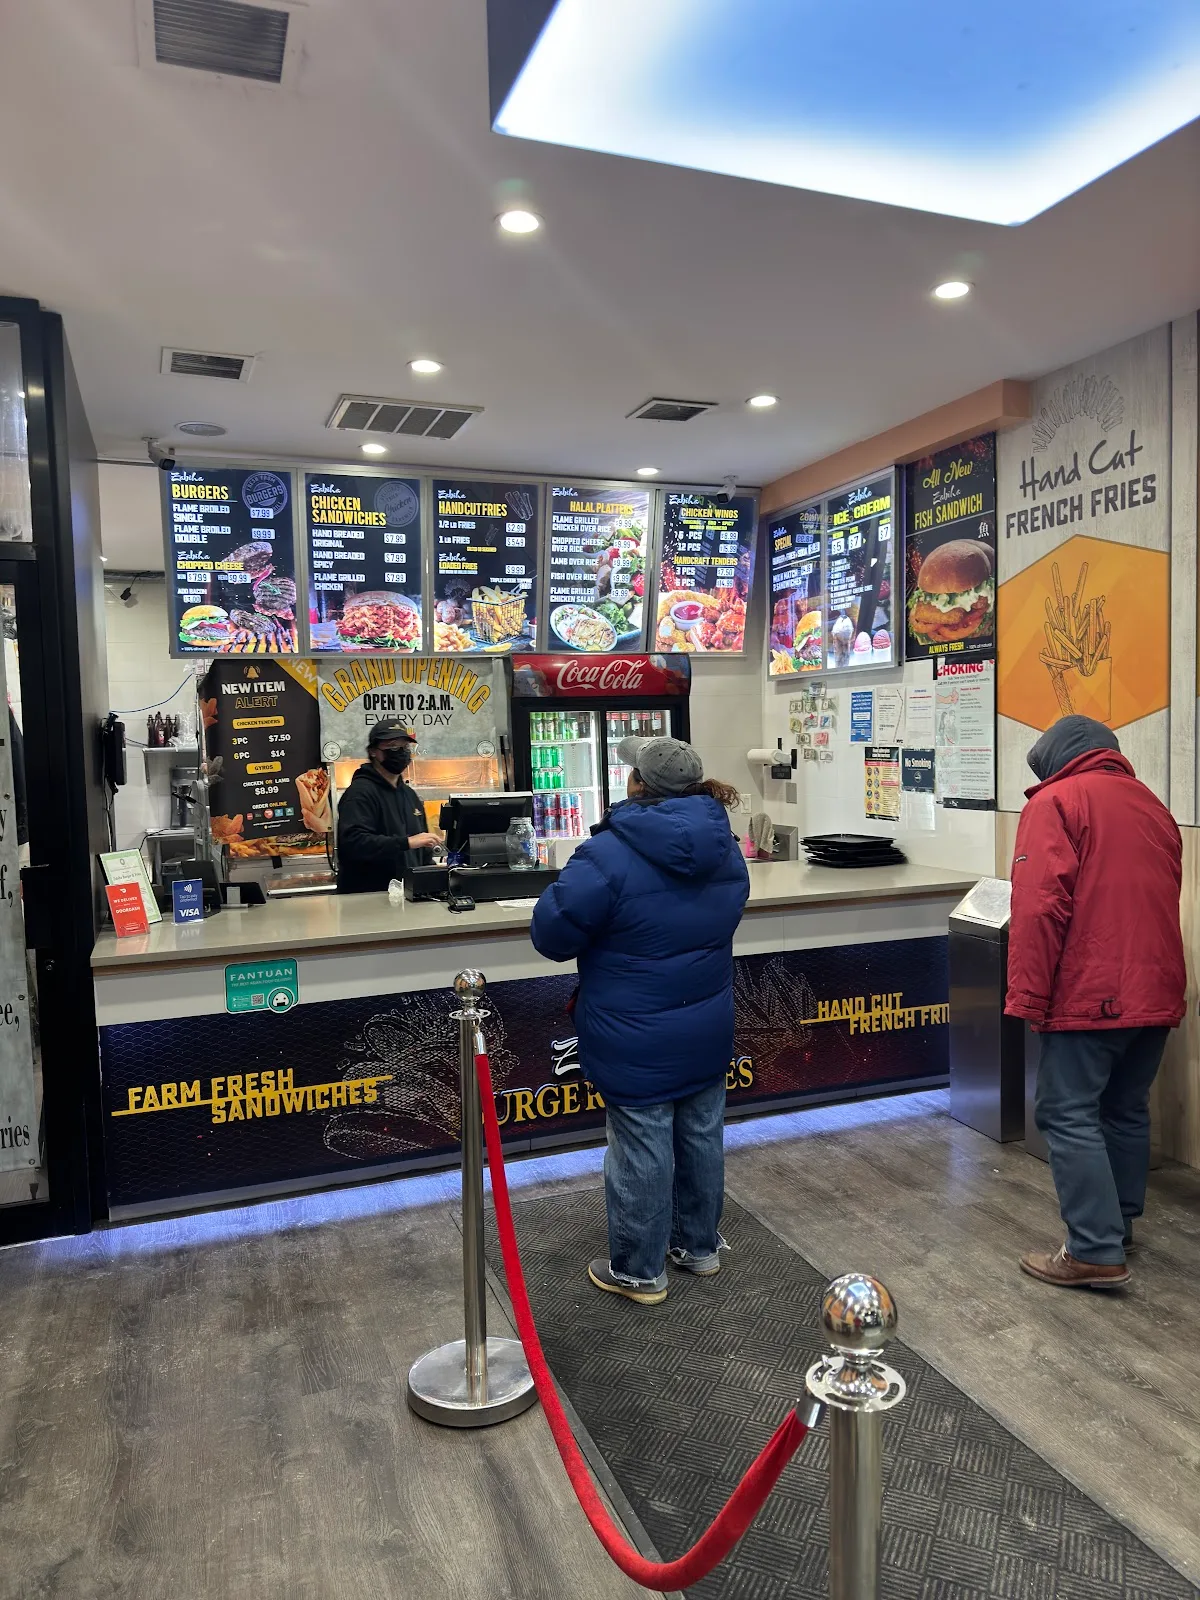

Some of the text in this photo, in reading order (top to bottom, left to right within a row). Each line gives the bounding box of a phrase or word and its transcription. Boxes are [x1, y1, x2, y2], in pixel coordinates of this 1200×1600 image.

[1019, 430, 1144, 501] Hand Cut
[171, 471, 204, 482] Zabiha
[923, 459, 973, 488] All New
[172, 484, 229, 500] BURGERS
[247, 485, 284, 504] BURGERS
[932, 485, 961, 505] Zabiha
[172, 504, 230, 514] FLAME BROILED
[312, 496, 360, 510] CHICKEN
[482, 503, 508, 516] FRIES
[570, 501, 634, 514] HALAL PLATTERS
[1006, 473, 1156, 539] FRENCH FRIES
[173, 509, 271, 522] SINGLE $7.99
[681, 508, 738, 518] CHICKEN WINGS
[834, 510, 850, 525] ICE
[854, 495, 890, 518] CREAM
[915, 493, 982, 530] FISH SANDWICH
[312, 510, 386, 526] SANDWICHES
[616, 520, 632, 528] $9.99
[174, 525, 232, 534] FLAME BROILED
[312, 529, 364, 539] HAND BREADED
[506, 524, 524, 532] $2.99
[978, 521, 989, 538] 魚
[175, 530, 272, 543] DOUBLE $9.99
[312, 534, 404, 548] ORIGINAL $7.99
[452, 536, 470, 544] FRIES
[506, 538, 524, 547] $5.49
[775, 535, 792, 551] SPECIAL
[833, 540, 842, 554] $5
[850, 535, 860, 549] $7
[880, 526, 889, 540] $7
[614, 540, 631, 548] $9.99
[678, 543, 701, 551] 12 PCS
[334, 552, 365, 560] BREADED
[385, 554, 404, 562] $7.99
[674, 556, 738, 566] HANDCRAFT TENDERS
[177, 561, 244, 570] CHOPPED CHEESE
[614, 559, 630, 567] $9.99
[506, 566, 524, 574] $9.99
[188, 572, 248, 582] $7.99 $9.99
[314, 573, 337, 581] FLAME
[386, 573, 404, 582] $7.99
[613, 574, 630, 582] $9.99
[612, 589, 628, 597] $9.99
[929, 642, 964, 654] ALWAYS FRESH
[288, 659, 318, 683] NEW
[556, 659, 647, 690] Coca-Cola
[937, 664, 984, 676] CHOKING
[222, 681, 285, 695] NEW ITEM
[320, 658, 491, 714] GRAND OPENING
[235, 696, 278, 709] ALERT
[363, 694, 454, 710] OPEN TO 2:A.M.
[423, 714, 452, 725] DAY
[268, 734, 291, 742] $7.50
[905, 758, 911, 767] No
[912, 758, 931, 770] Smoking
[255, 786, 279, 796] $8.99
[179, 908, 200, 917] VISA
[230, 968, 292, 981] FANTUAN
[818, 992, 903, 1020] HAND CUT
[850, 1009, 915, 1035] FRENCH
[128, 1068, 293, 1111] FARM FRESH
[211, 1082, 377, 1124] SANDWICHES
